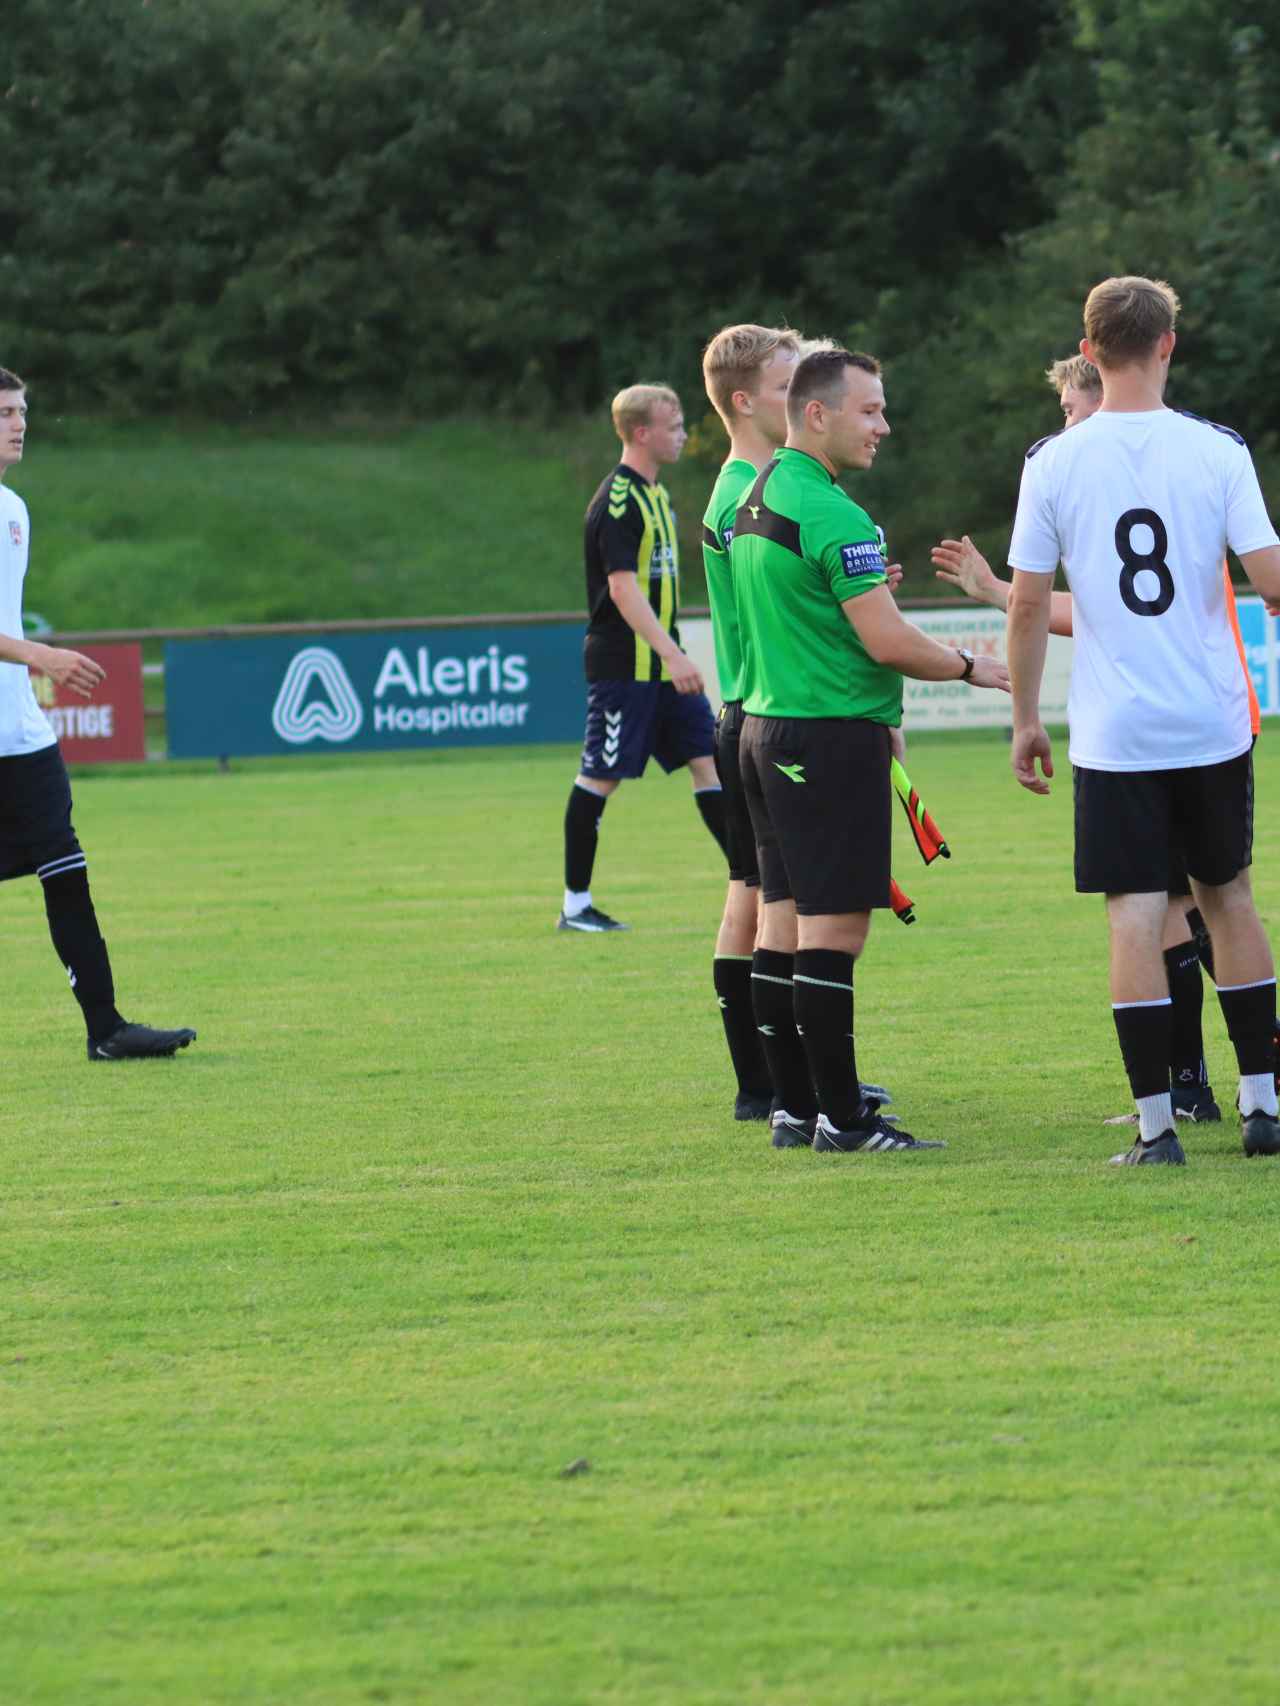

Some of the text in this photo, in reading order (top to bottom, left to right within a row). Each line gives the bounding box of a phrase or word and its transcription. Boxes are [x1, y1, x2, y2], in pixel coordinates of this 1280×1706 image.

[1114, 507, 1175, 617] 8
[373, 645, 529, 697] Aleris
[373, 701, 529, 735] Hospitaler
